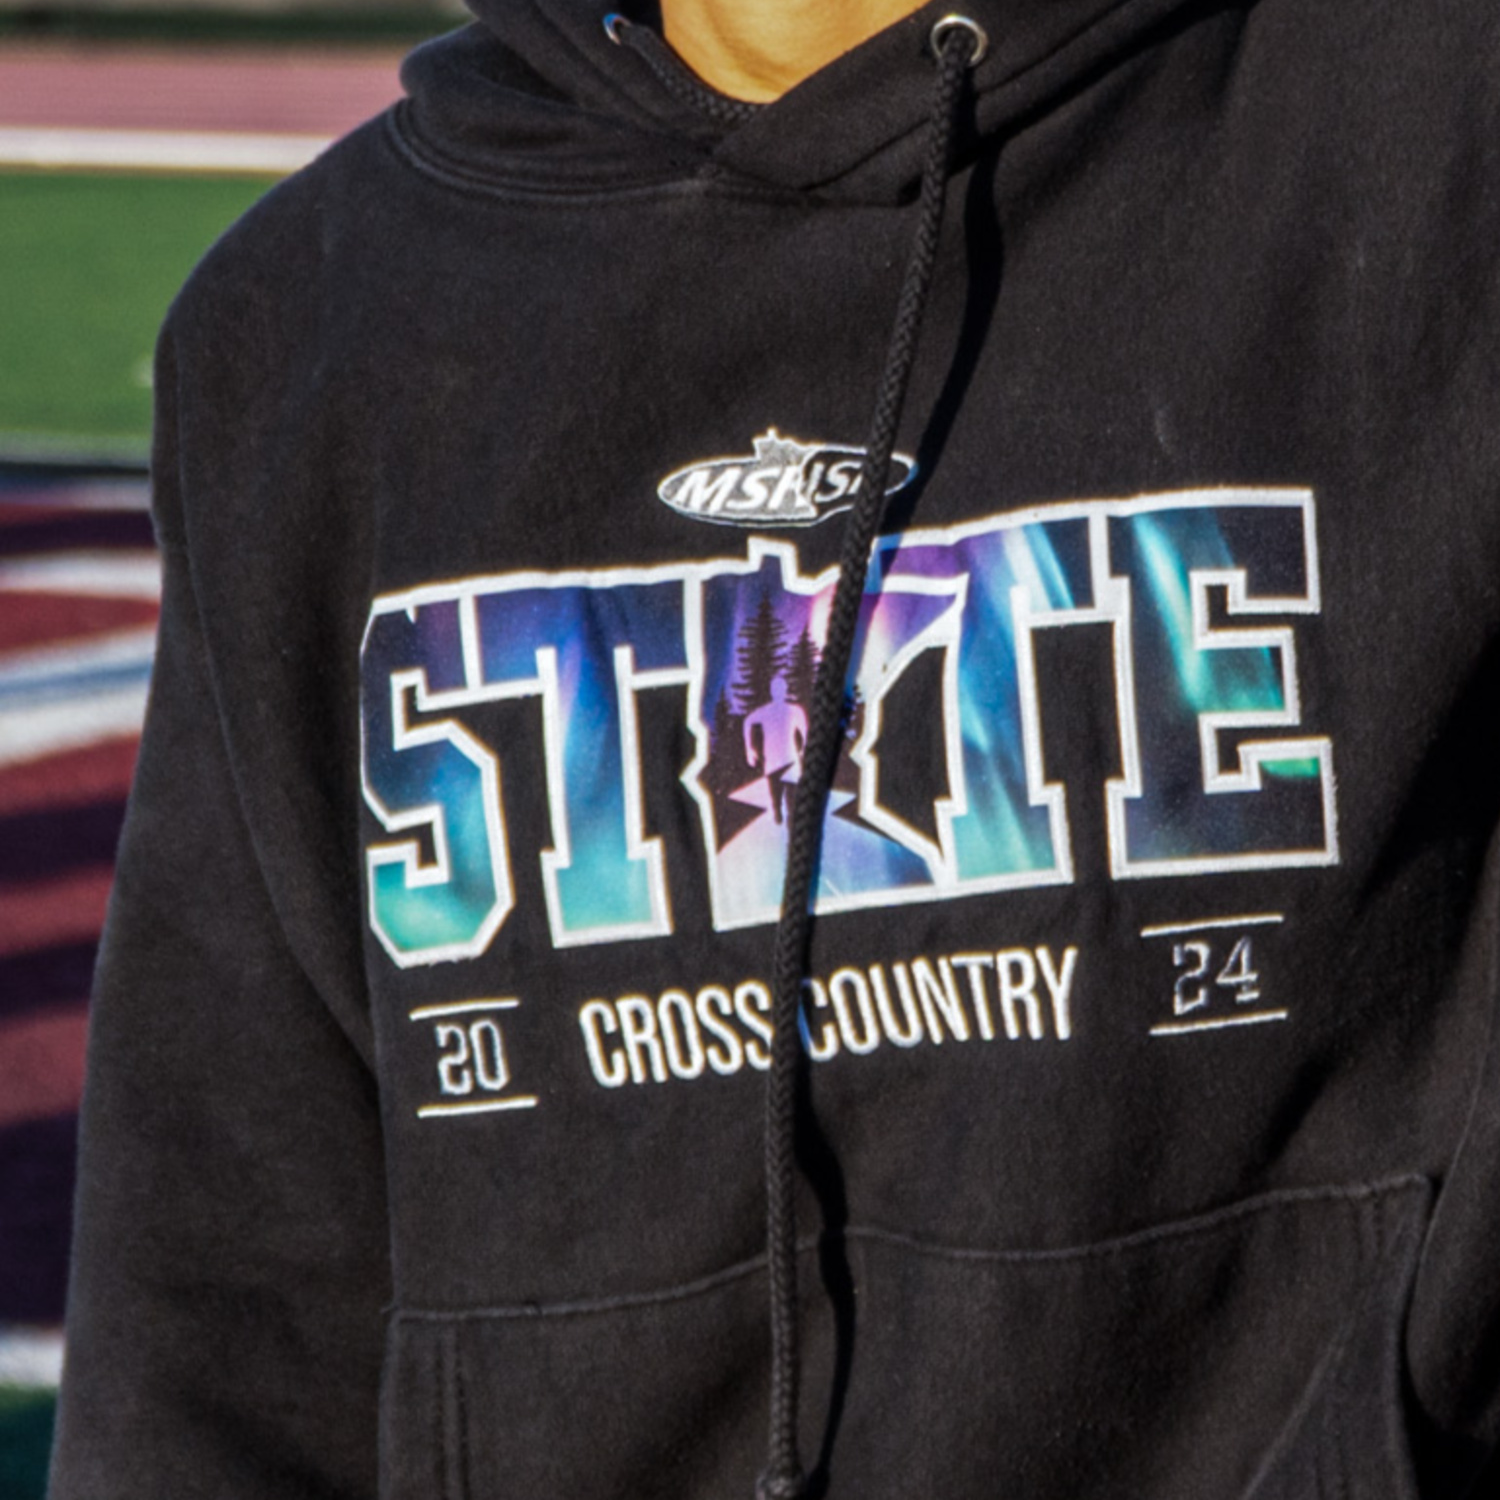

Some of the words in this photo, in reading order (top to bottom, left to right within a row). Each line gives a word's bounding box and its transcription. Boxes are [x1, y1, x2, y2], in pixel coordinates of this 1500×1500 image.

[672, 460, 866, 514] MSHS
[360, 486, 1338, 968] STATE
[438, 1020, 508, 1095] 20
[578, 980, 772, 1090] CROSS
[797, 946, 1078, 1063] COUNTRY
[1171, 937, 1260, 1016] 24
